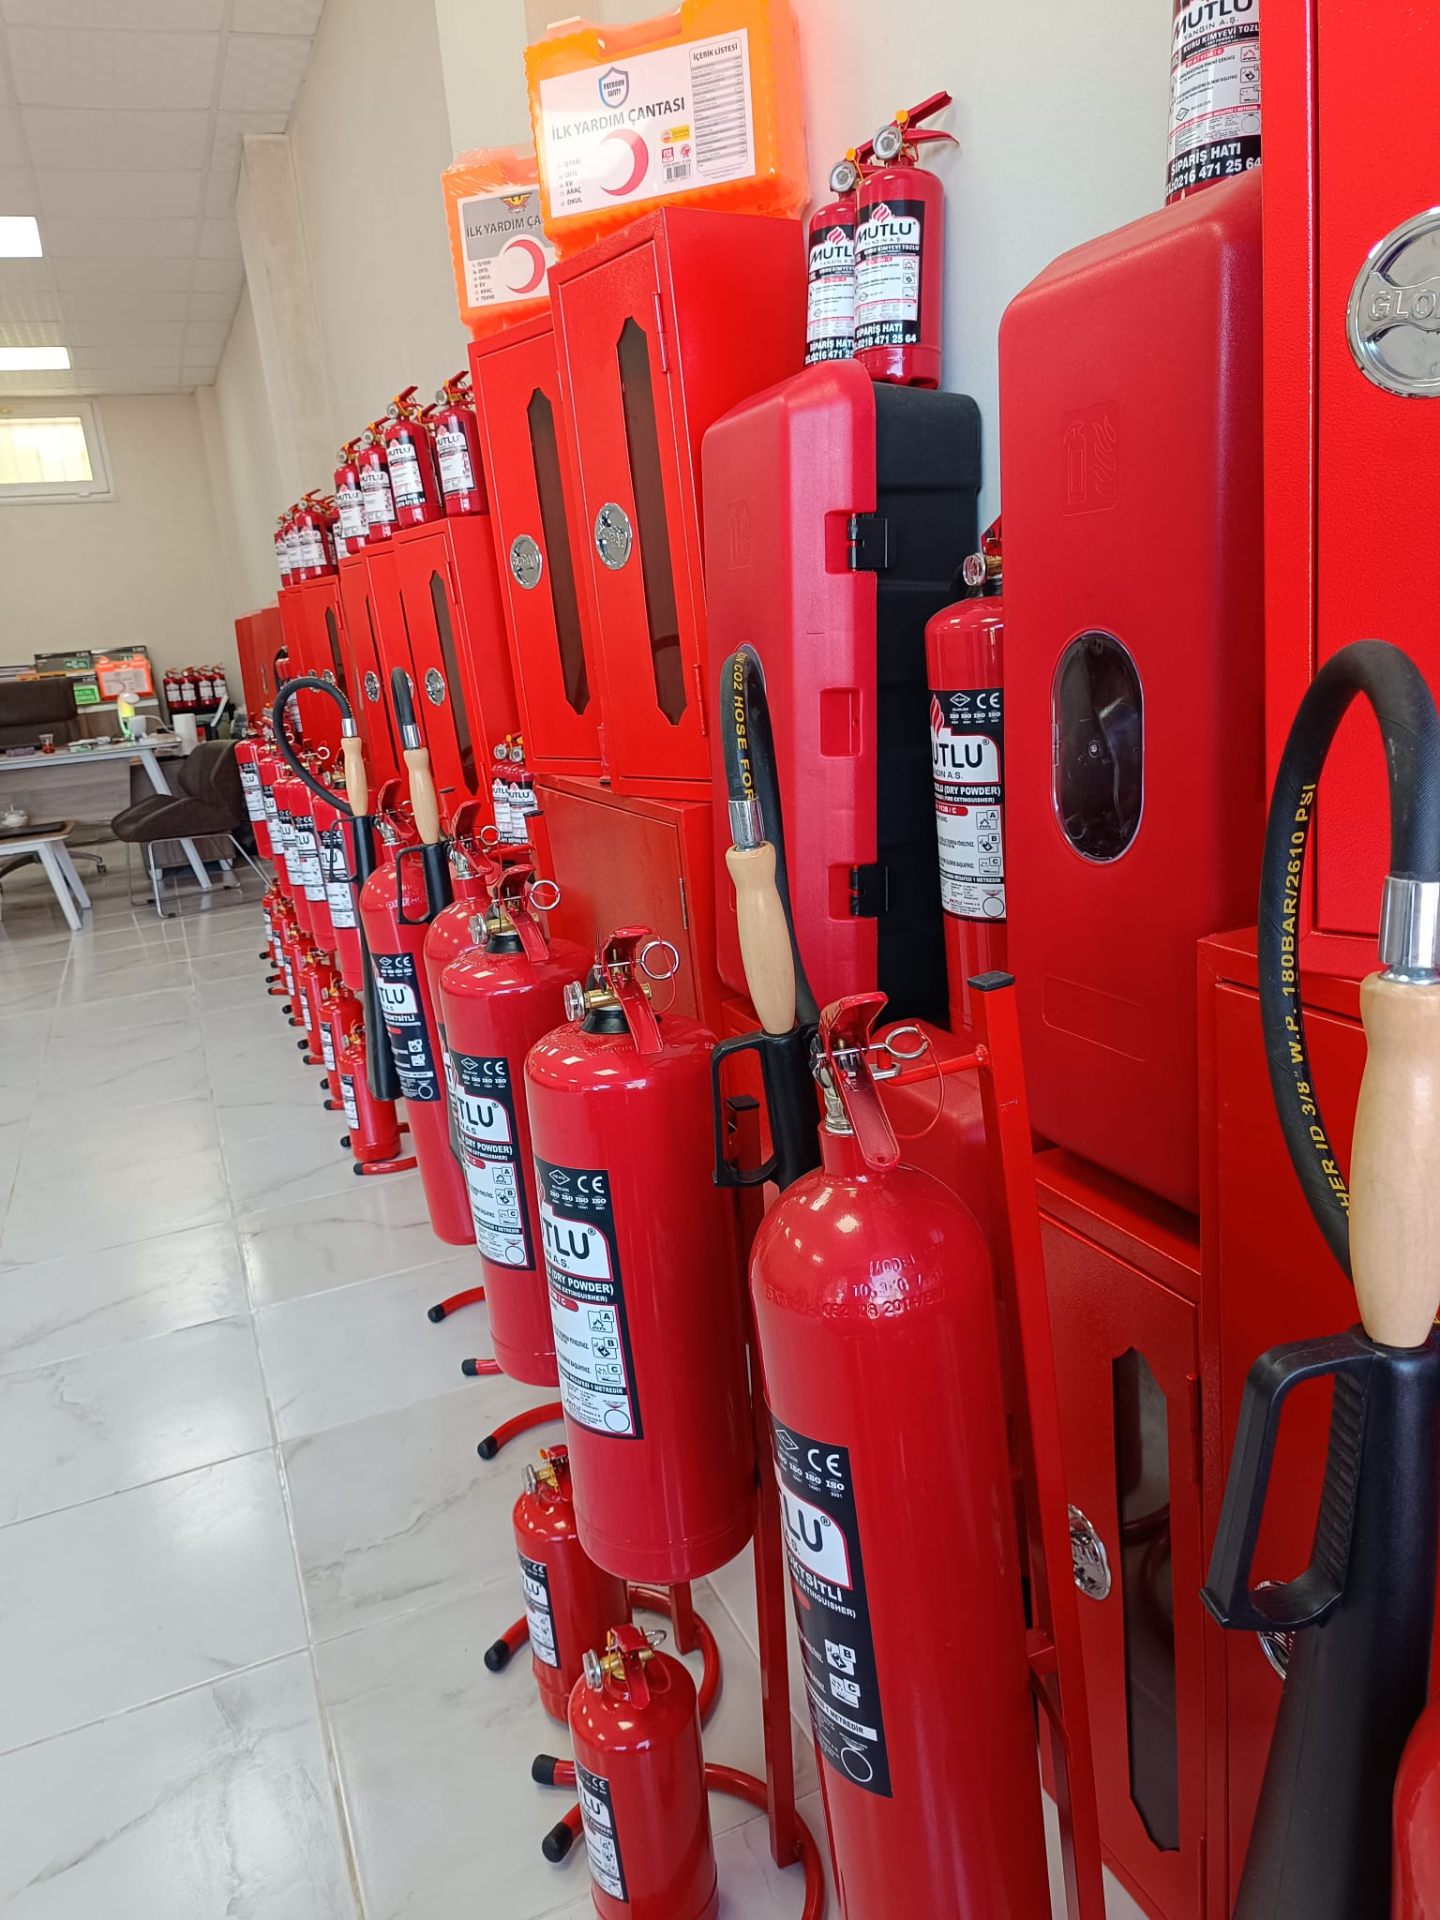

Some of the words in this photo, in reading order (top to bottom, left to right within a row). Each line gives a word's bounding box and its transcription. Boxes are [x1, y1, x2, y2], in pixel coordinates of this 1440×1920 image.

[1183, 39, 1201, 54] KURU
[1201, 26, 1237, 44] KİMYEVİ
[1238, 23, 1260, 33] TOZL
[693, 49, 714, 61] İÇERİK
[714, 42, 738, 55] LİSTESİ
[551, 124, 572, 142] İLK
[573, 110, 626, 136] YARDIM
[627, 96, 686, 126] ÇANTASI
[1171, 149, 1208, 176] SİPARİŞ
[1210, 142, 1241, 160] HATI
[1198, 162, 1221, 179] 471
[1225, 158, 1242, 174] 25
[1245, 156, 1261, 171] 64
[466, 224, 483, 238] İLK
[483, 218, 525, 235] YARDIM
[526, 214, 544, 230] ÇA
[856, 222, 913, 243] MUTLU
[811, 245, 855, 264] MUTL
[1366, 288, 1440, 321] GLO
[881, 323, 903, 334] HATI
[874, 336, 891, 346] 471
[892, 335, 903, 344] 25
[905, 334, 917, 343] 64
[828, 351, 843, 361] 471
[733, 664, 744, 690] CO2
[976, 692, 1001, 709] CE
[734, 695, 748, 750] HOSE
[933, 743, 983, 769] UTLU
[944, 784, 959, 795] (DRY
[960, 786, 1001, 797] POWDER)
[1294, 783, 1317, 823] PSI
[1280, 830, 1306, 997] 180BAR/2610
[395, 956, 412, 968] CE
[1284, 1008, 1304, 1064] W.P.
[483, 1061, 506, 1076] CE
[1310, 1124, 1329, 1150] ID
[477, 1142, 513, 1156] POWDER)
[577, 1175, 605, 1194] CE
[1320, 1157, 1350, 1218] HER
[575, 1196, 589, 1204] ISO
[551, 1268, 567, 1285] (DRY
[567, 1277, 614, 1297] POWDER)
[561, 1286, 608, 1303] EXTINGUISHER)
[603, 1312, 611, 1320] A
[607, 1339, 615, 1347] B
[807, 1448, 842, 1478] CE
[805, 1471, 822, 1485] ISO
[825, 1479, 845, 1491] ISO
[843, 1648, 852, 1659] B
[847, 1682, 856, 1693] C
